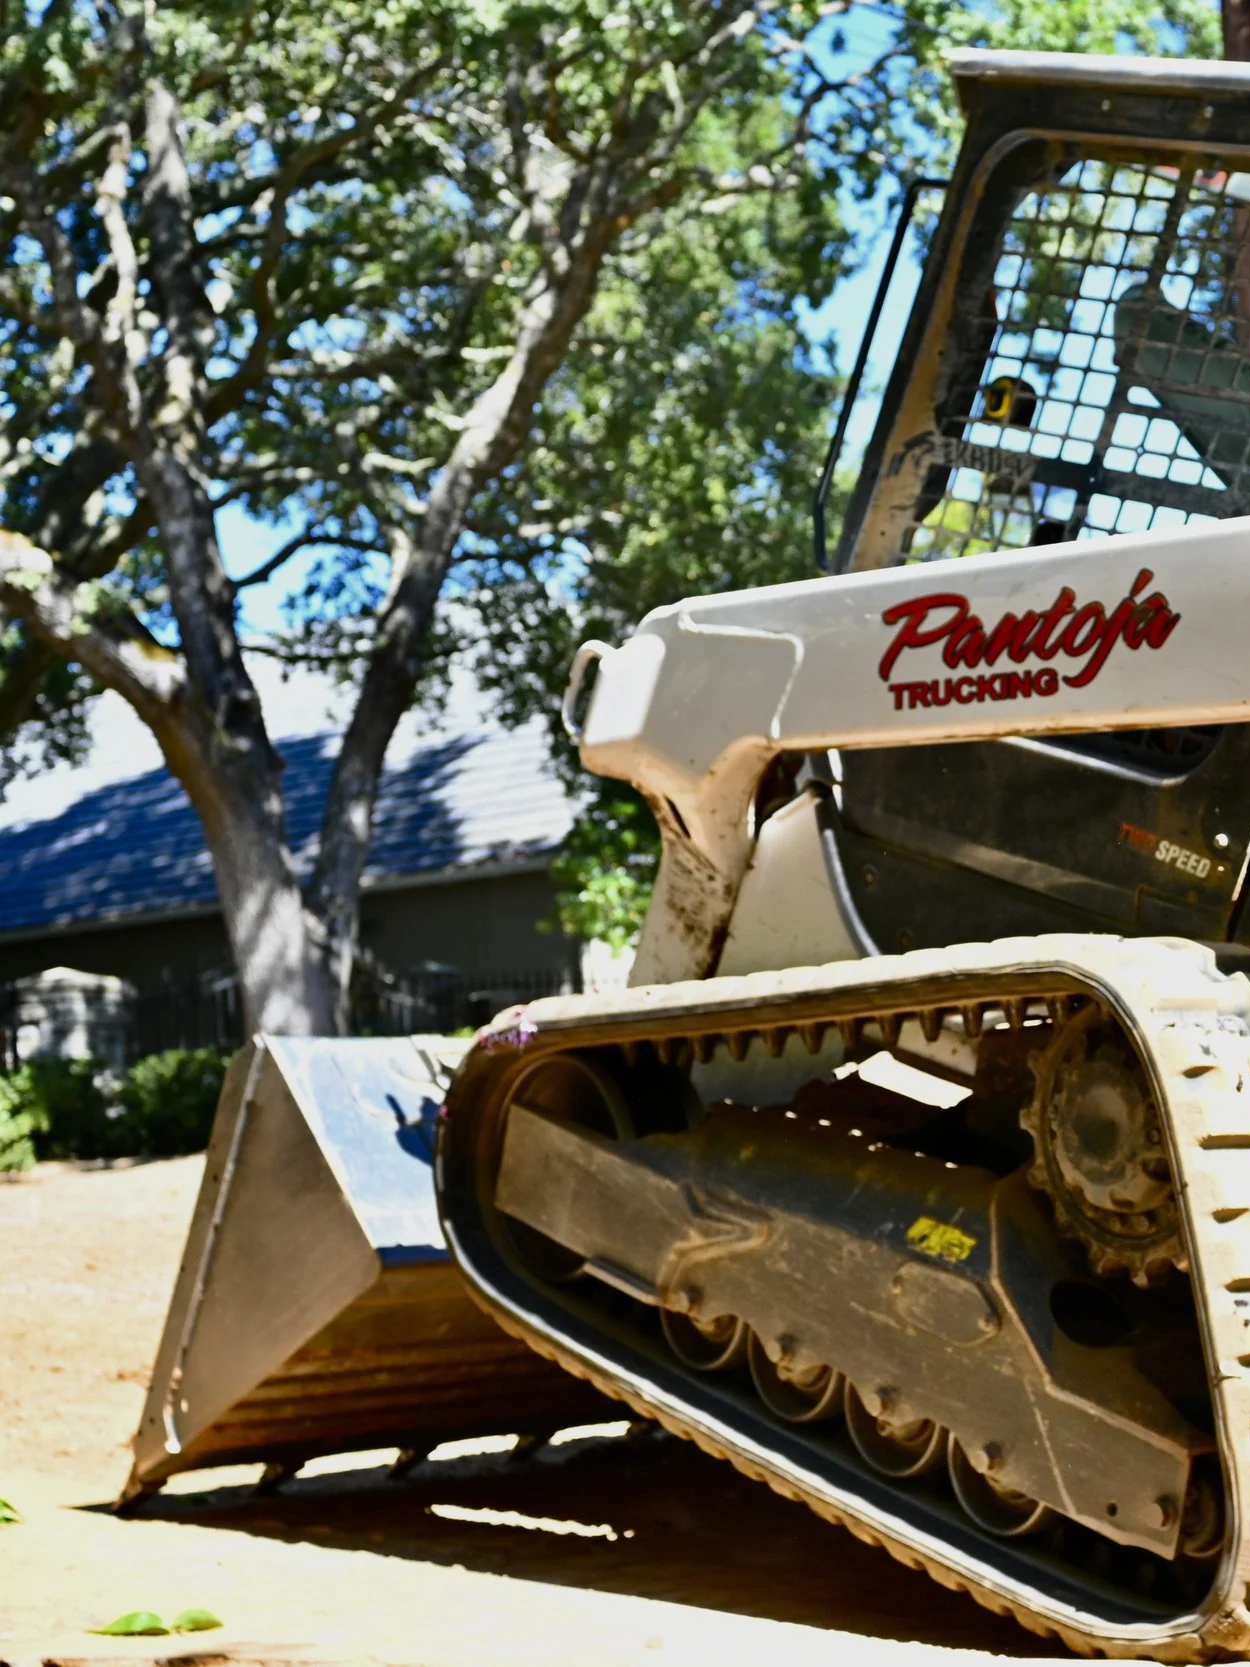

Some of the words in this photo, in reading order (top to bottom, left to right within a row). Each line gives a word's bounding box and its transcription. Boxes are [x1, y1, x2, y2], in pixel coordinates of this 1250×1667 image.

[878, 568, 1181, 688] Pantoja
[888, 667, 1060, 711] TRUCKING
[1154, 840, 1211, 879] SPEED
